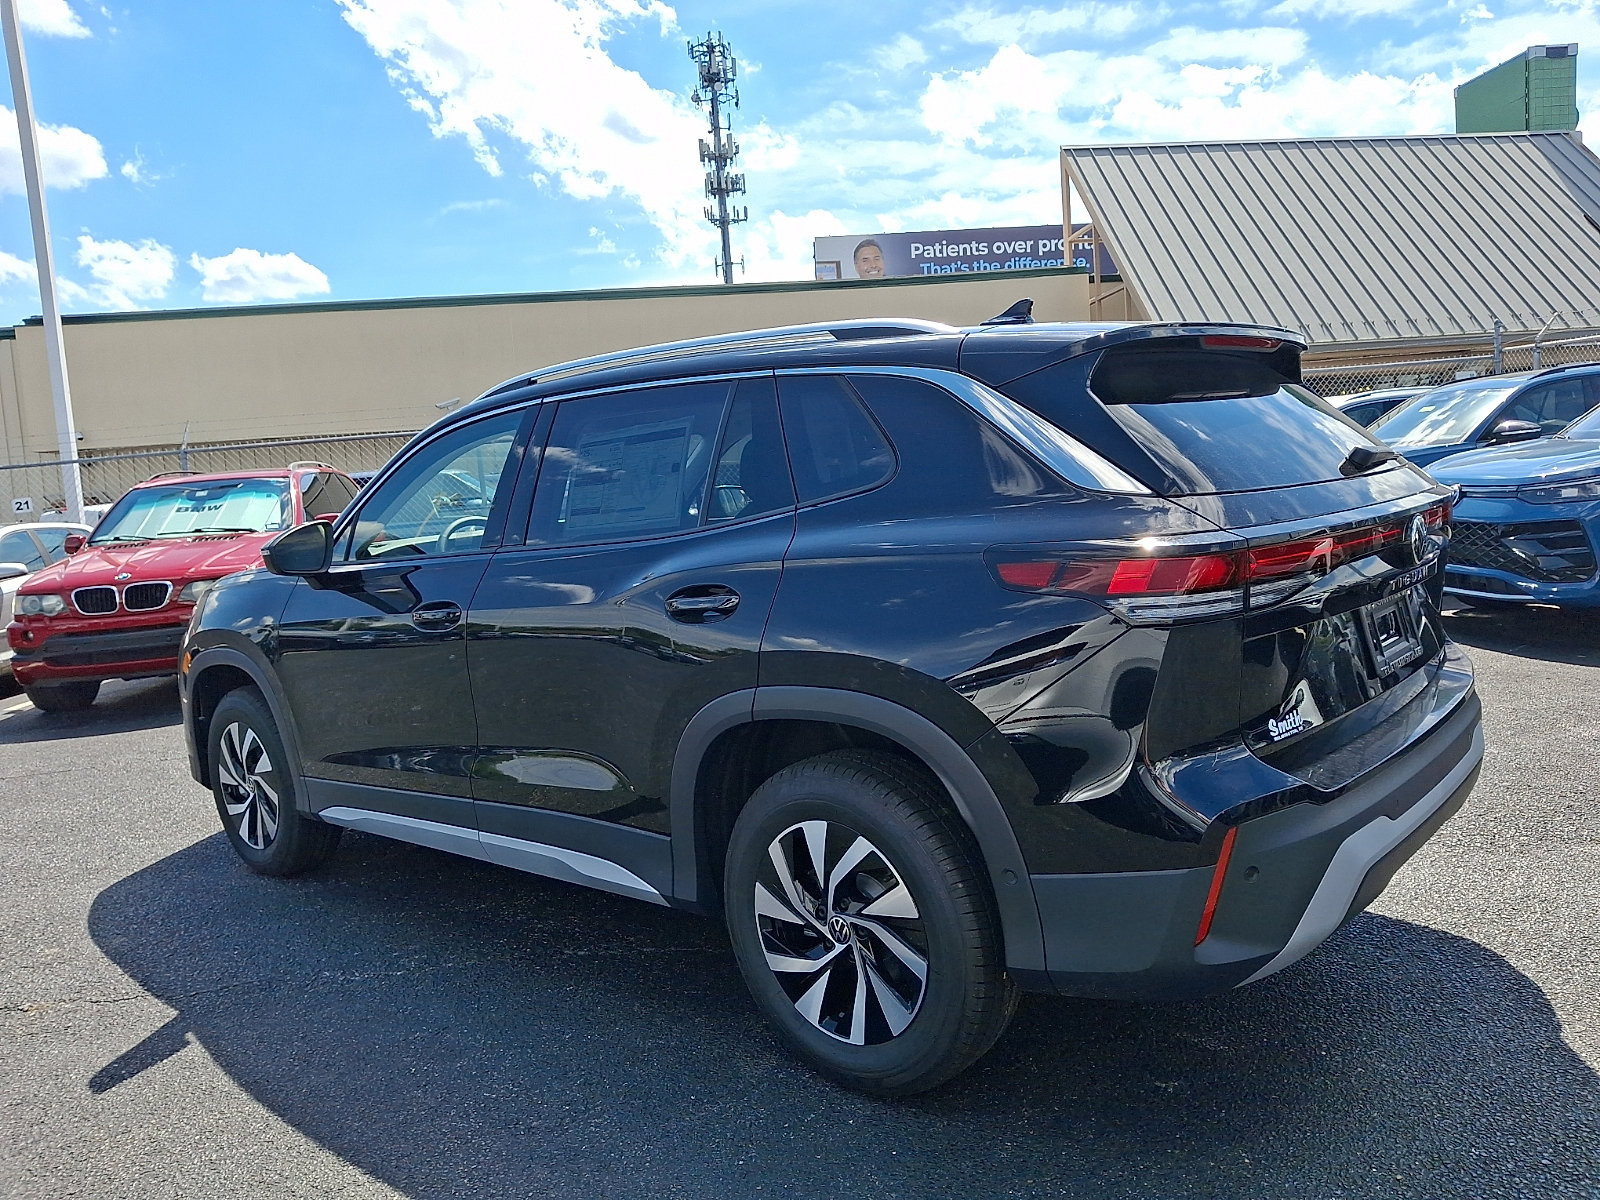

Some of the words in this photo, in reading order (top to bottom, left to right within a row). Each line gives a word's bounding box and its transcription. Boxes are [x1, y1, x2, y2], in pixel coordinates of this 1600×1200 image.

[911, 240, 989, 259] Patients
[993, 240, 1034, 255] over
[920, 261, 970, 276] That's
[973, 259, 1001, 272] the
[15, 500, 30, 511] 21
[175, 503, 224, 513] BMW
[1388, 565, 1428, 591] TIGUAN
[1268, 709, 1304, 737] Smith
